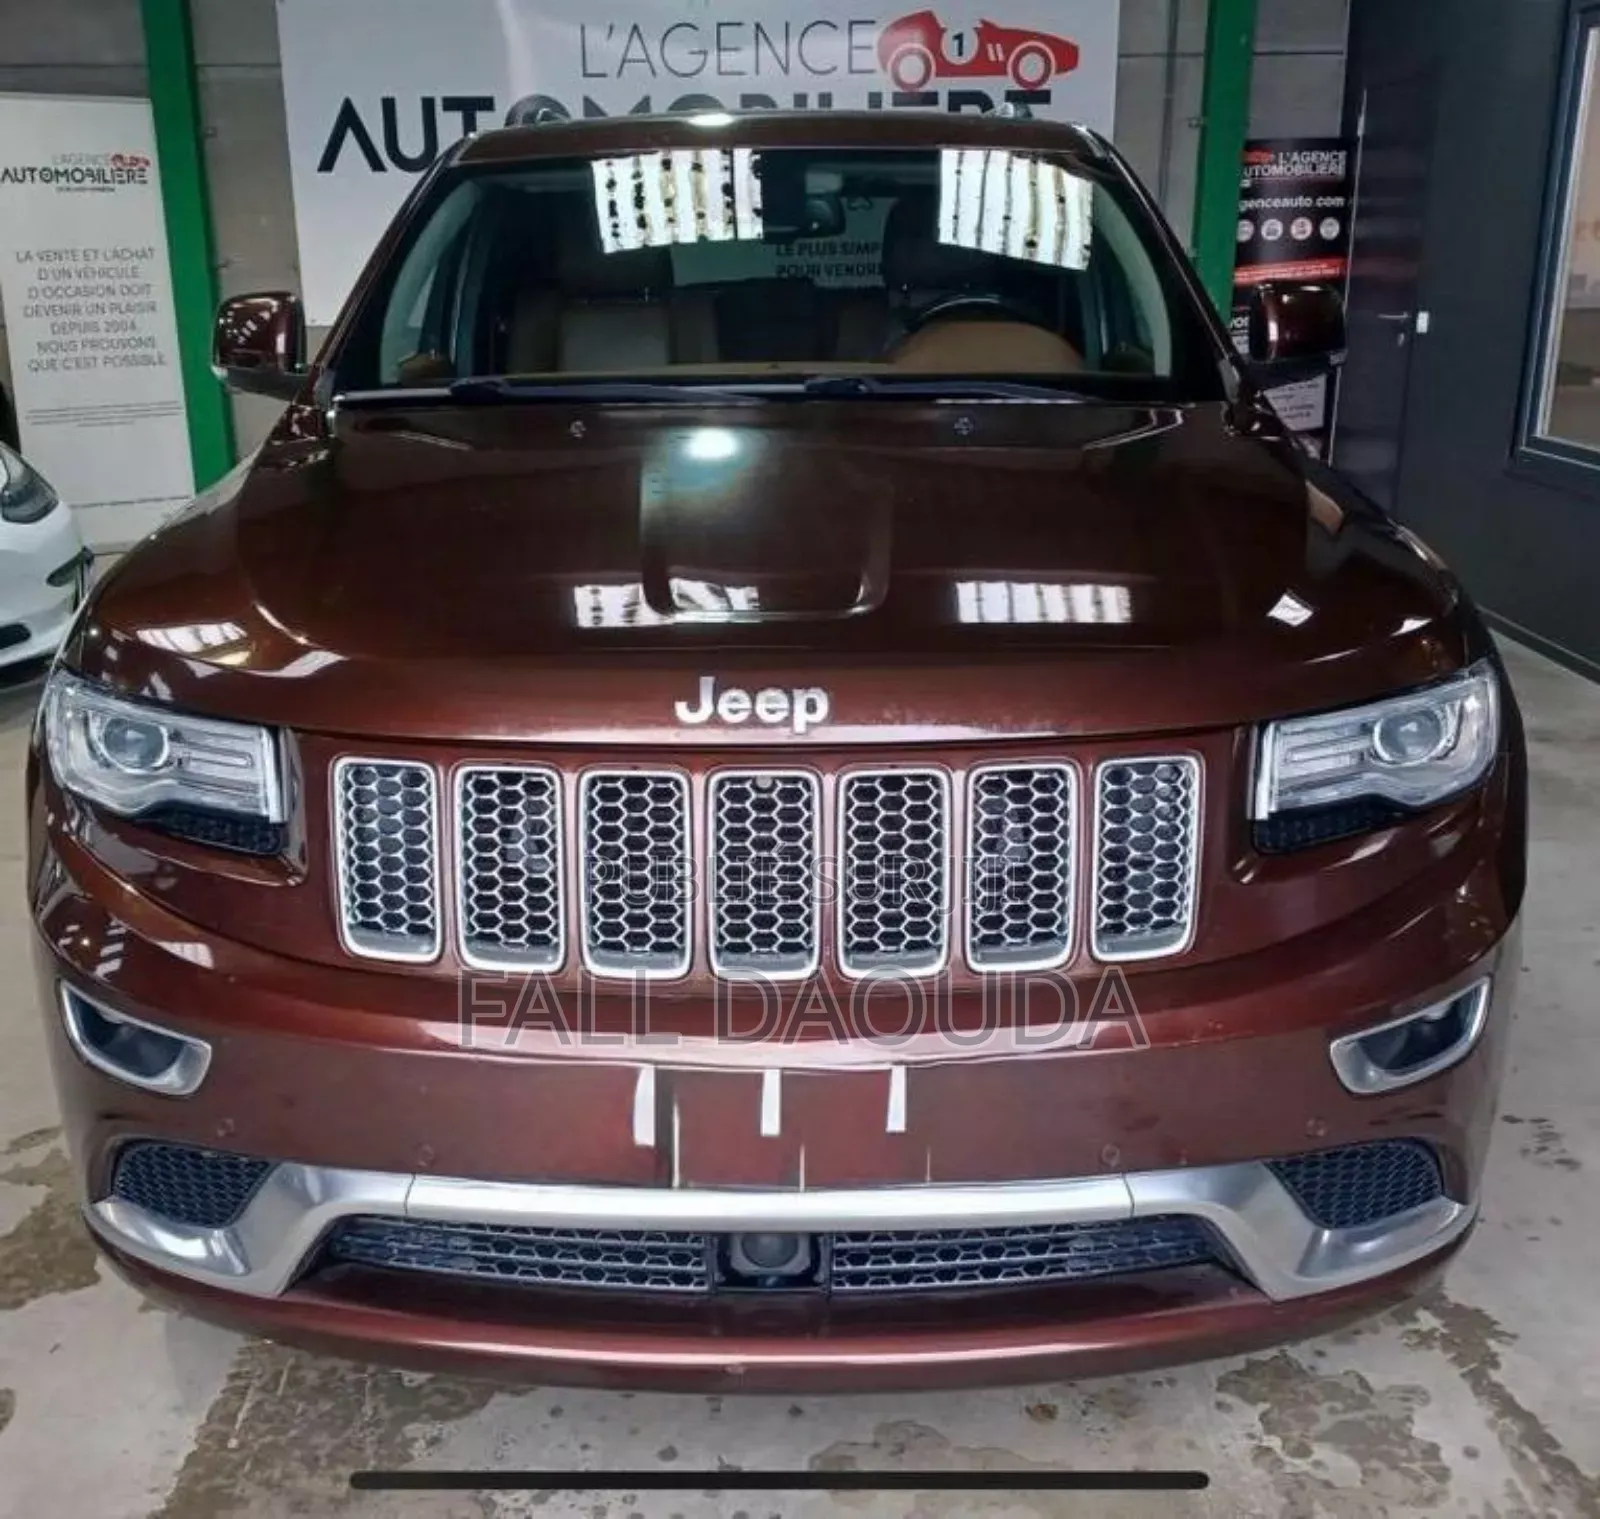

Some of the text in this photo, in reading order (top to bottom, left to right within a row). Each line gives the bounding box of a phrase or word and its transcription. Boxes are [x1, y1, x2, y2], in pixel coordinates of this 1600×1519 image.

[579, 20, 877, 79] L'AGENCE
[952, 32, 964, 57] 1
[674, 676, 829, 735] Jeep
